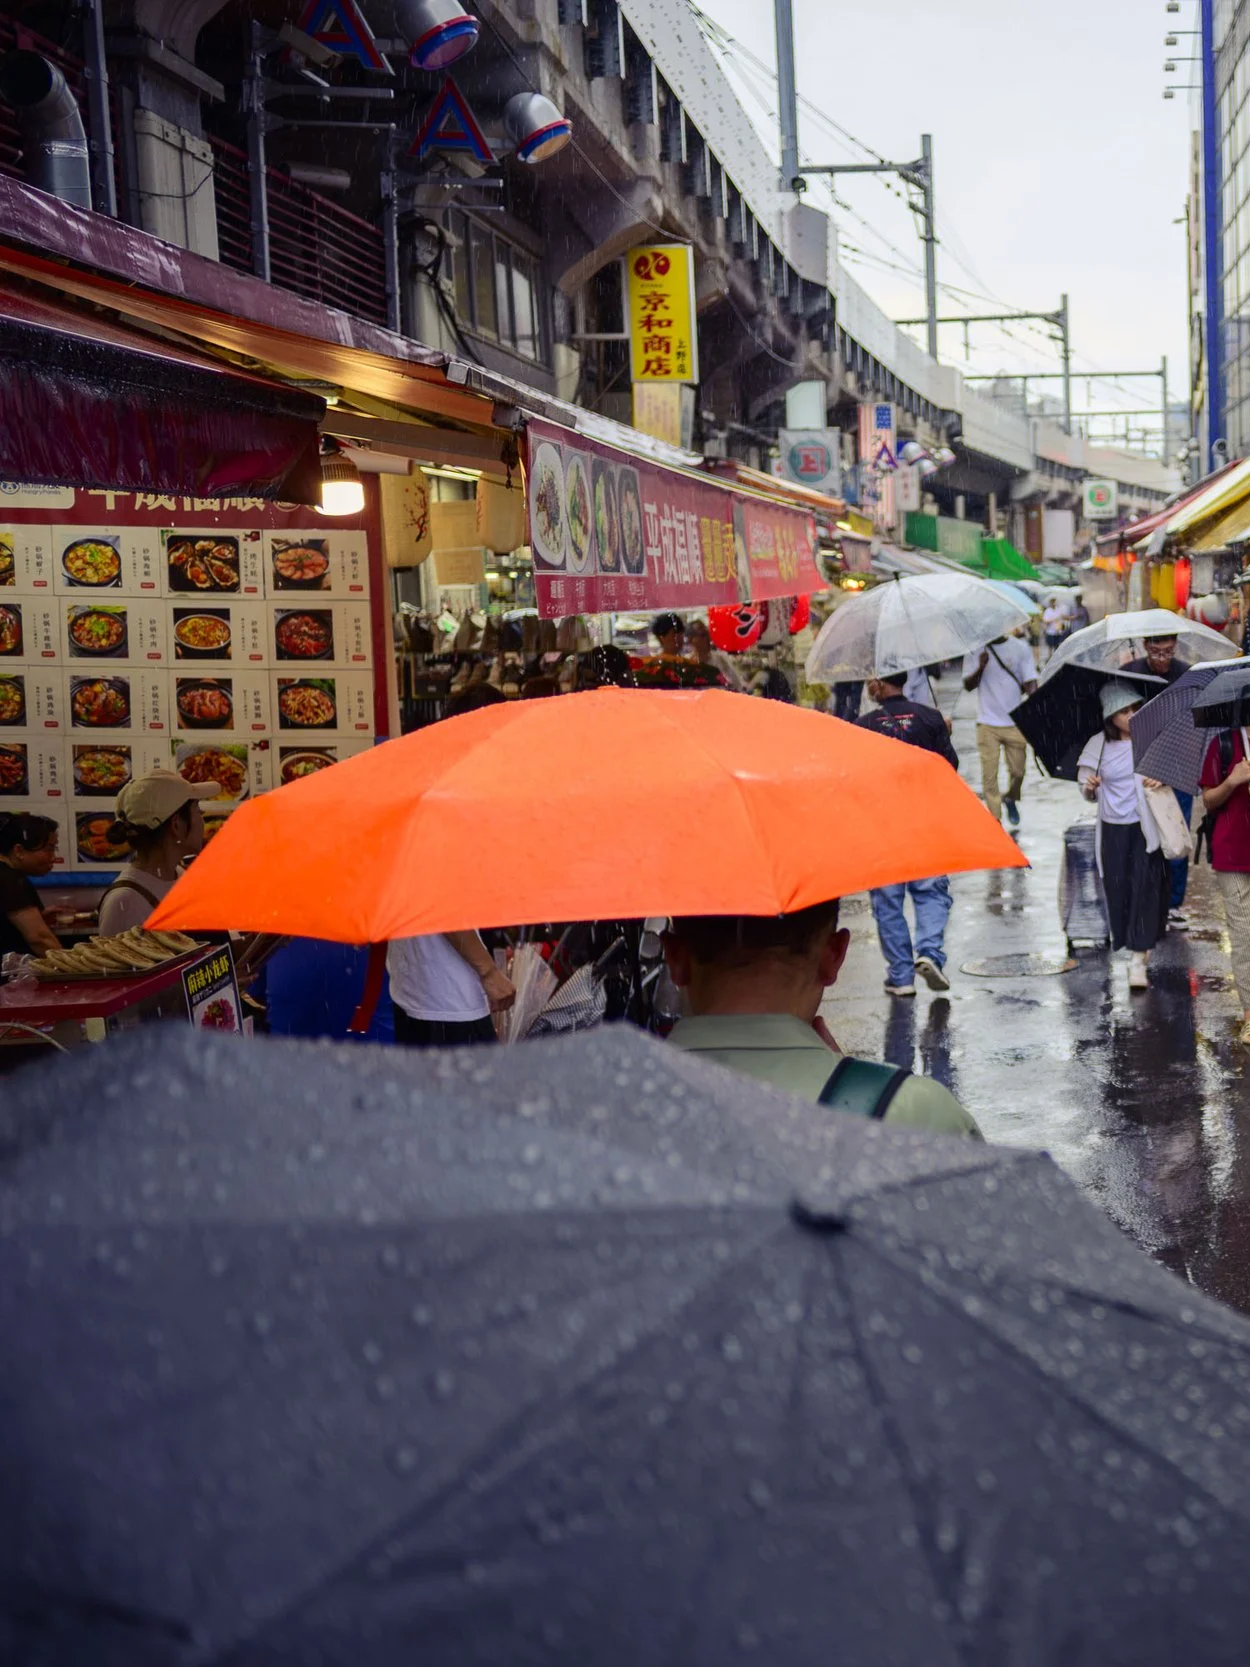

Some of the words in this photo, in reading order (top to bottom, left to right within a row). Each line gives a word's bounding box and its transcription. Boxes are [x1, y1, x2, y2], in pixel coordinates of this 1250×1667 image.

[638, 291, 673, 377] 京和商店
[643, 502, 704, 585] 平成福順
